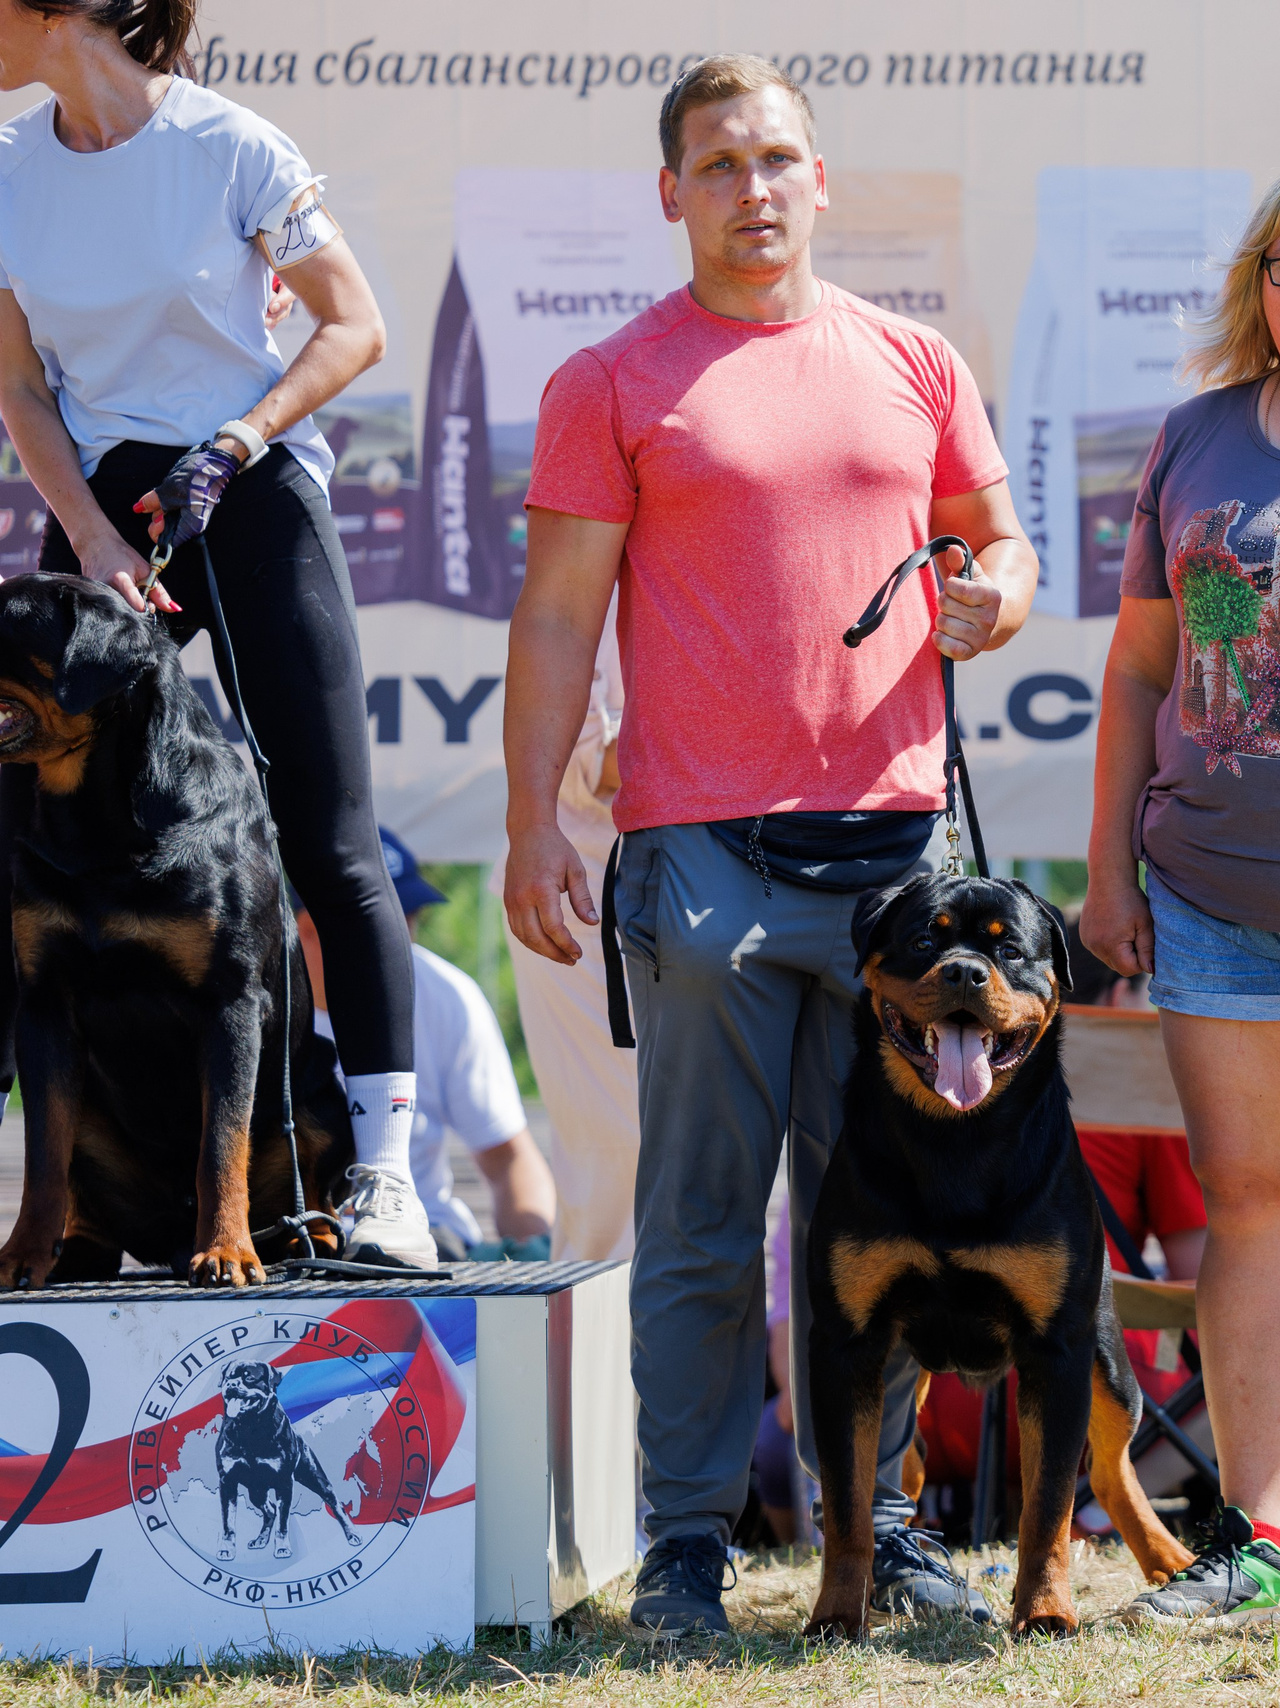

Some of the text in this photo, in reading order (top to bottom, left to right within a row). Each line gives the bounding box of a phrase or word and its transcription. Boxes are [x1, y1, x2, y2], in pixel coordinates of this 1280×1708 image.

[313, 38, 869, 98] сбалансирового
[886, 50, 1146, 86] питания
[1098, 288, 1212, 315] Hant
[443, 415, 471, 597] Hanta
[0, 1322, 103, 1605] 2
[134, 1319, 427, 1532] РОТВЕЙЛЕР КЛУБ РОССИИ
[202, 1558, 363, 1603] РКФ-НКПР
